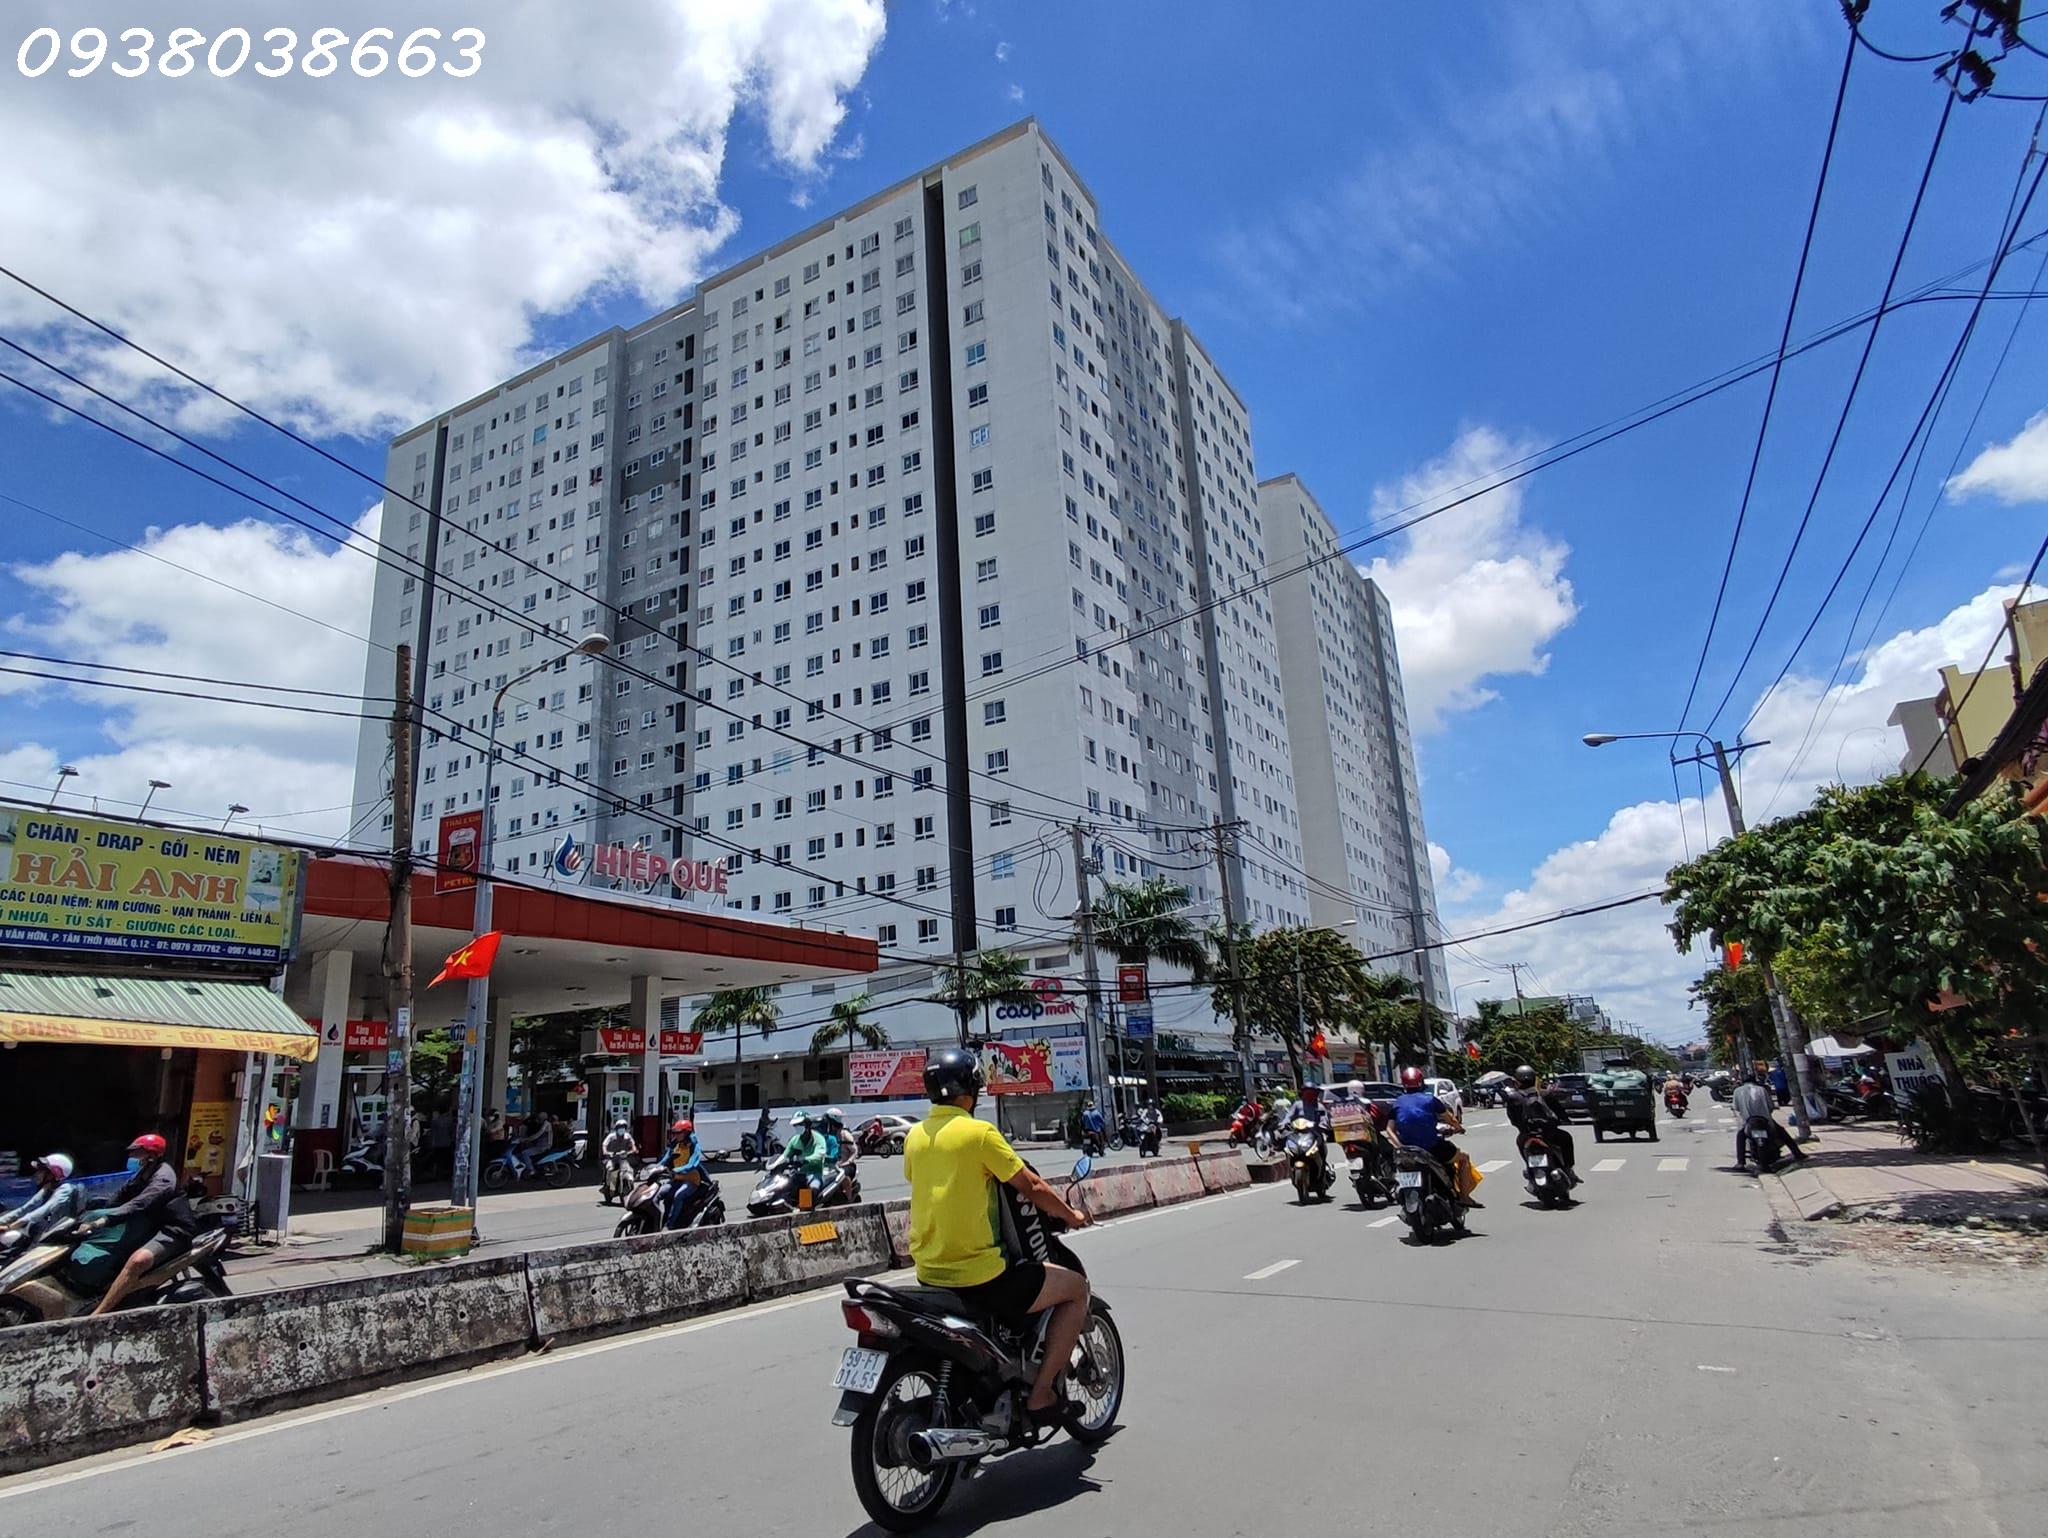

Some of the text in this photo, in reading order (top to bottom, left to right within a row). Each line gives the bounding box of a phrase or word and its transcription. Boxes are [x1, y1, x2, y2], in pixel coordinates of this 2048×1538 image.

[26, 822, 240, 866] CHĂN DRAP GỐI NỆM
[12, 847, 118, 892] HẢI
[128, 867, 241, 905] ANH
[0, 888, 26, 902] CÁC
[30, 891, 58, 907] LOẠI
[96, 898, 119, 911] KIM
[122, 900, 161, 915] CƯƠNG
[172, 905, 193, 919] VẠN
[8, 909, 49, 925] NHỰA
[65, 913, 82, 926] TỦ
[180, 922, 205, 936] CÁC
[852, 1070, 887, 1078] 200
[1896, 1054, 1926, 1071] NHÀ
[1025, 1217, 1050, 1262] YON
[846, 1350, 880, 1370] 59-F1
